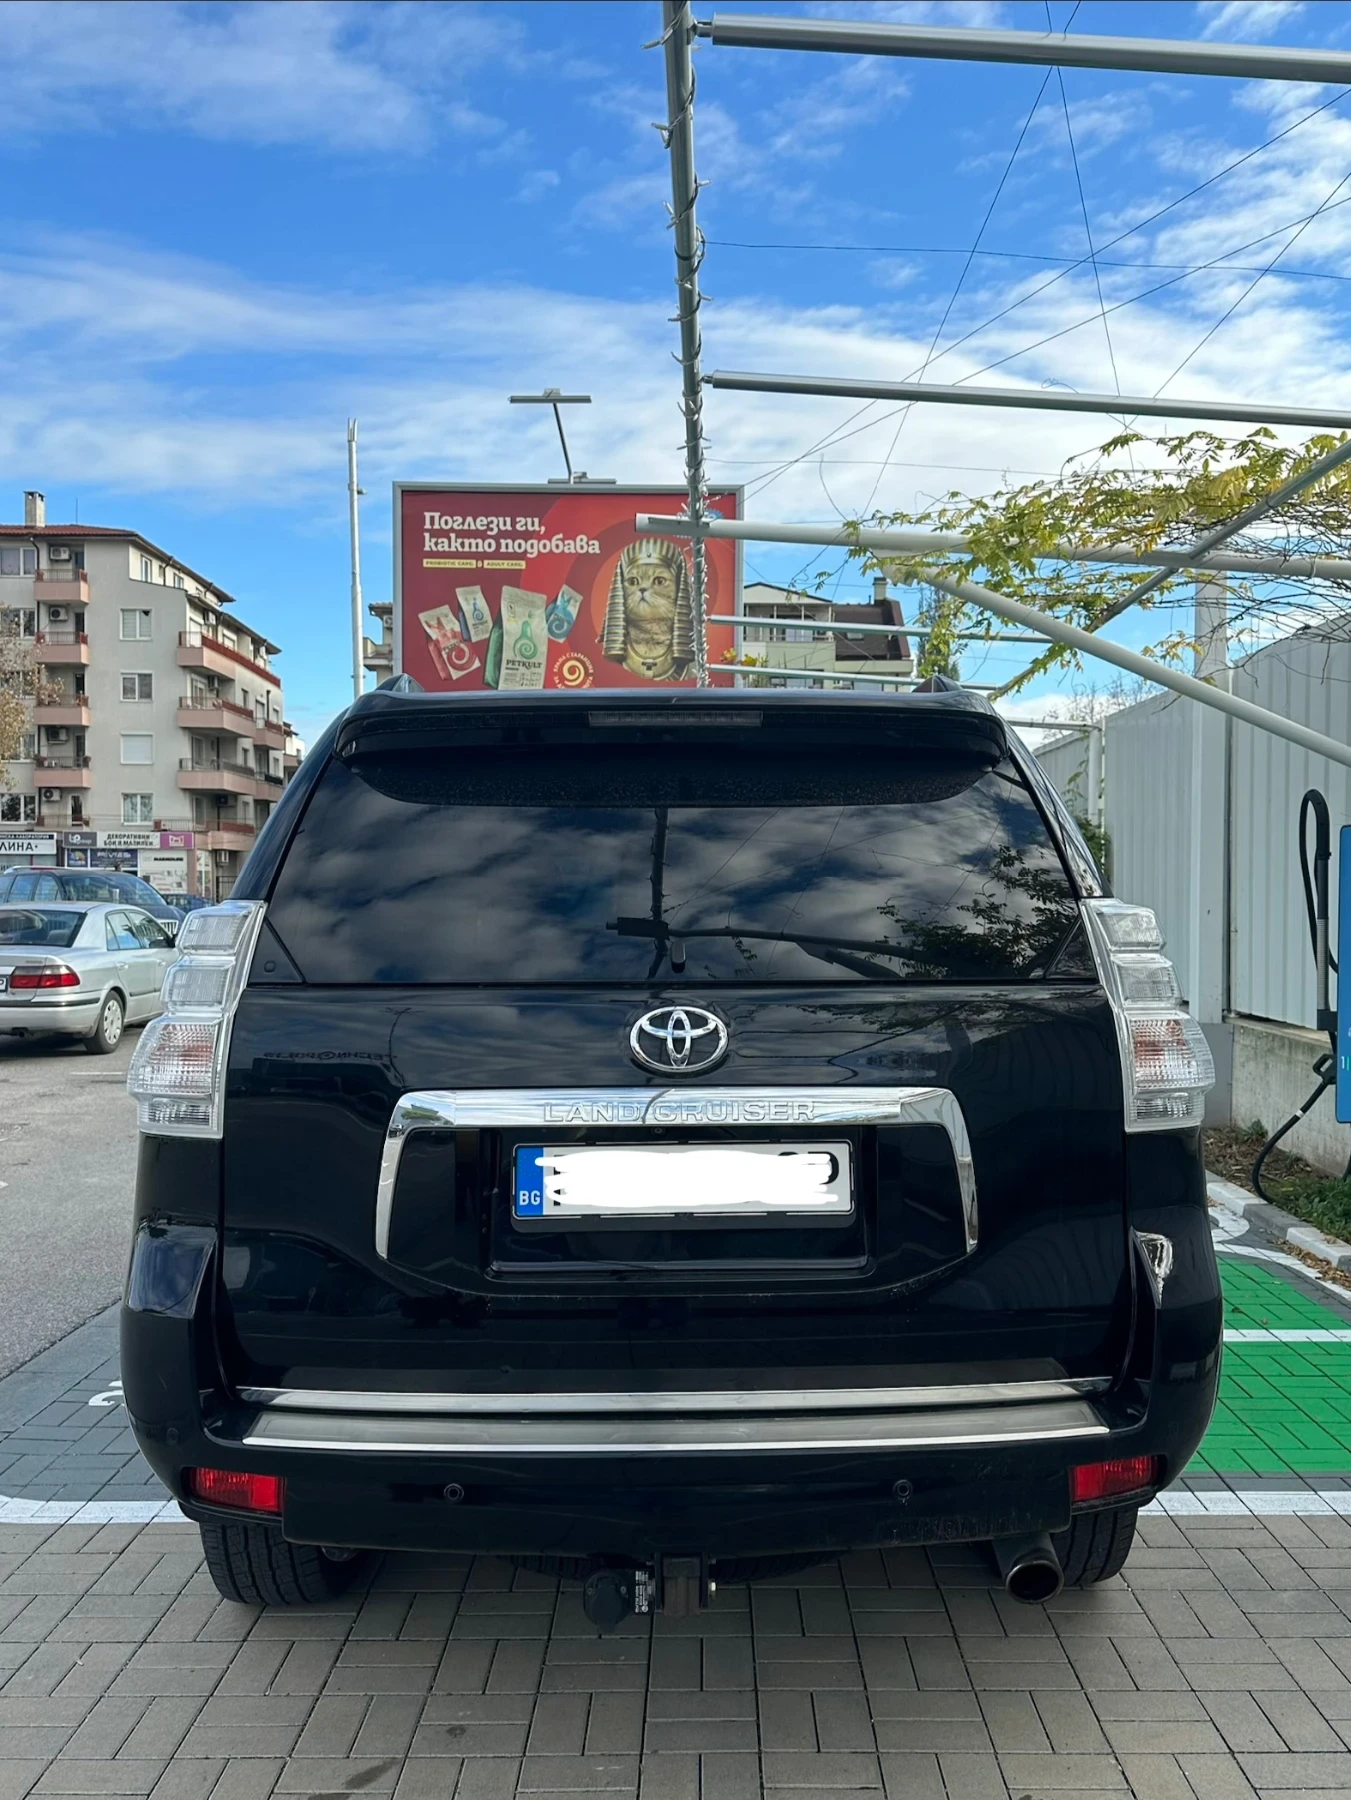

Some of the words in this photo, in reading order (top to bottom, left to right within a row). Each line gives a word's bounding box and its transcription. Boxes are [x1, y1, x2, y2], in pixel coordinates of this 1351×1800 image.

[423, 511, 512, 535] Поглези
[515, 516, 546, 534] ги,
[423, 532, 497, 552] както
[499, 533, 601, 558] подобава
[505, 659, 542, 670] PETKULT
[543, 1102, 641, 1122] LAND
[654, 1101, 815, 1121] CRUISER
[519, 1189, 541, 1206] BG
